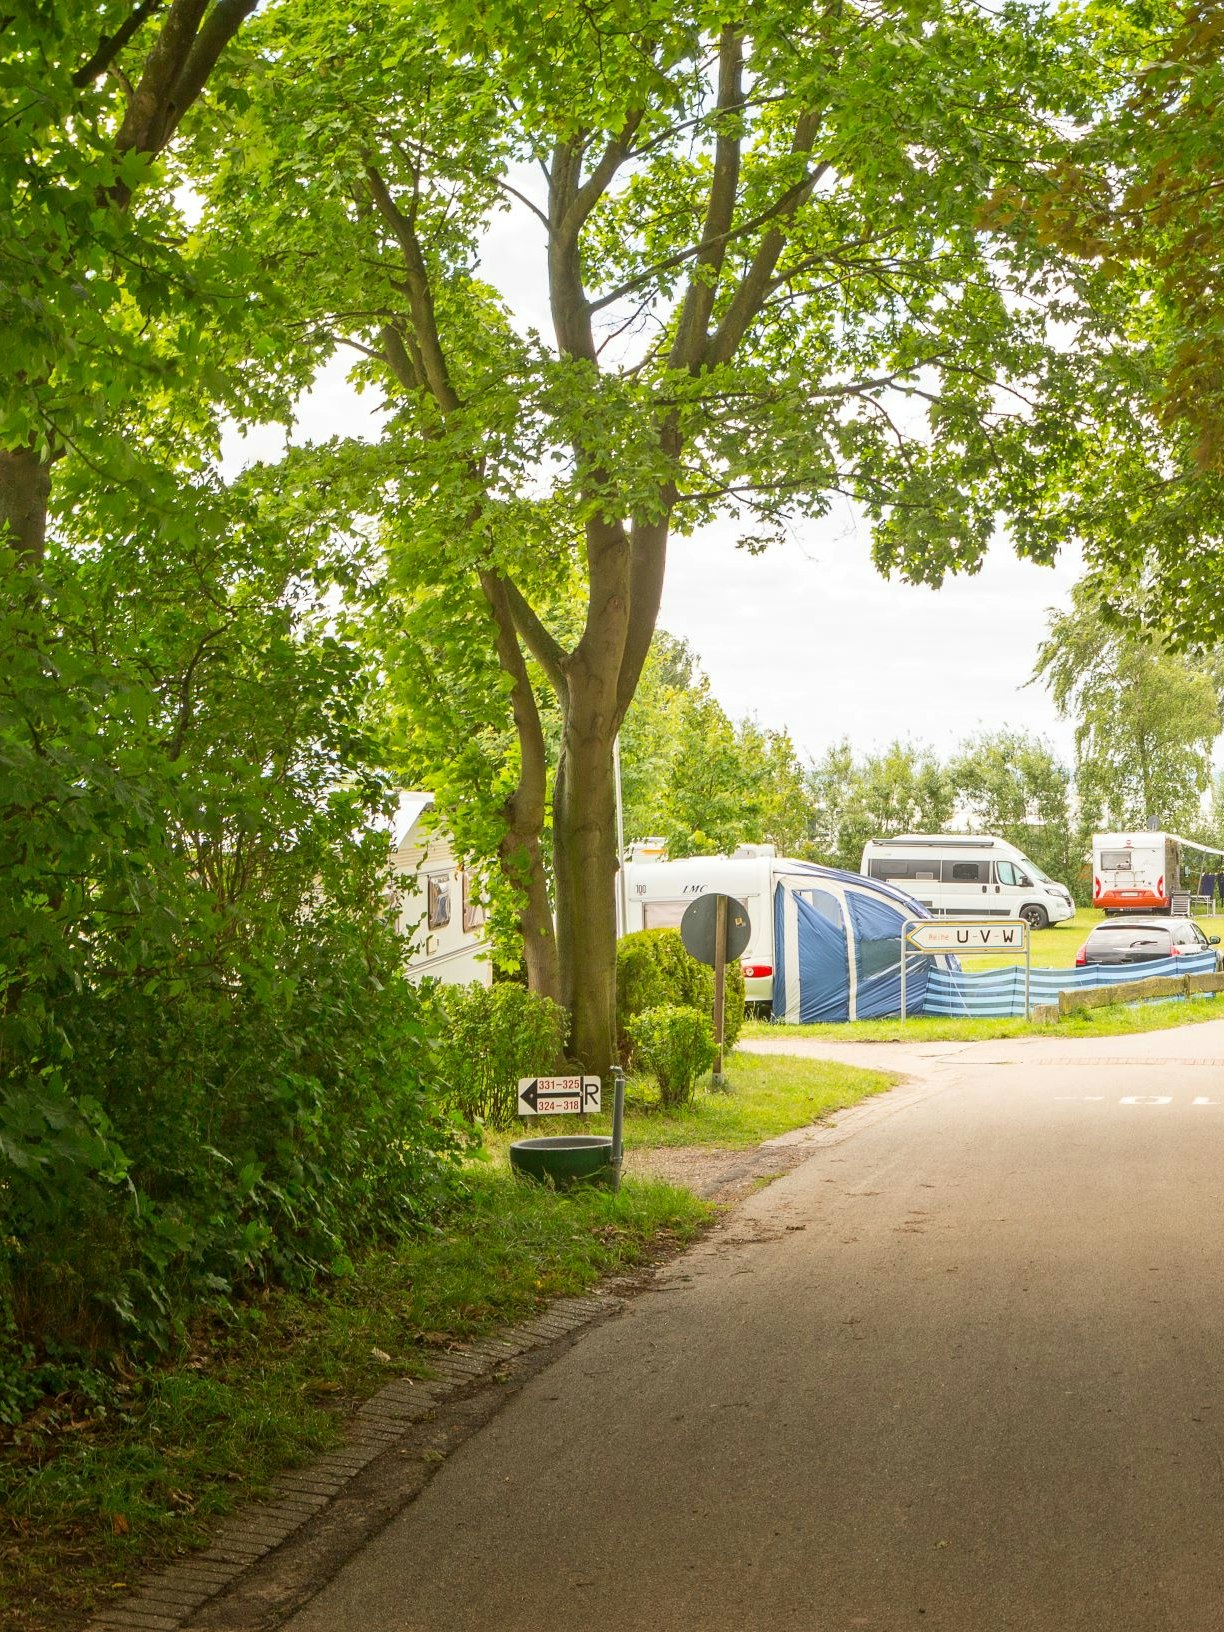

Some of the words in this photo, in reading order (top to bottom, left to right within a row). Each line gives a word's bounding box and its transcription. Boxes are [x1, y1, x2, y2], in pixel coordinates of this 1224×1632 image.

[538, 1079, 580, 1090] 331-325
[584, 1083, 599, 1106] R
[538, 1100, 579, 1111] 324-318
